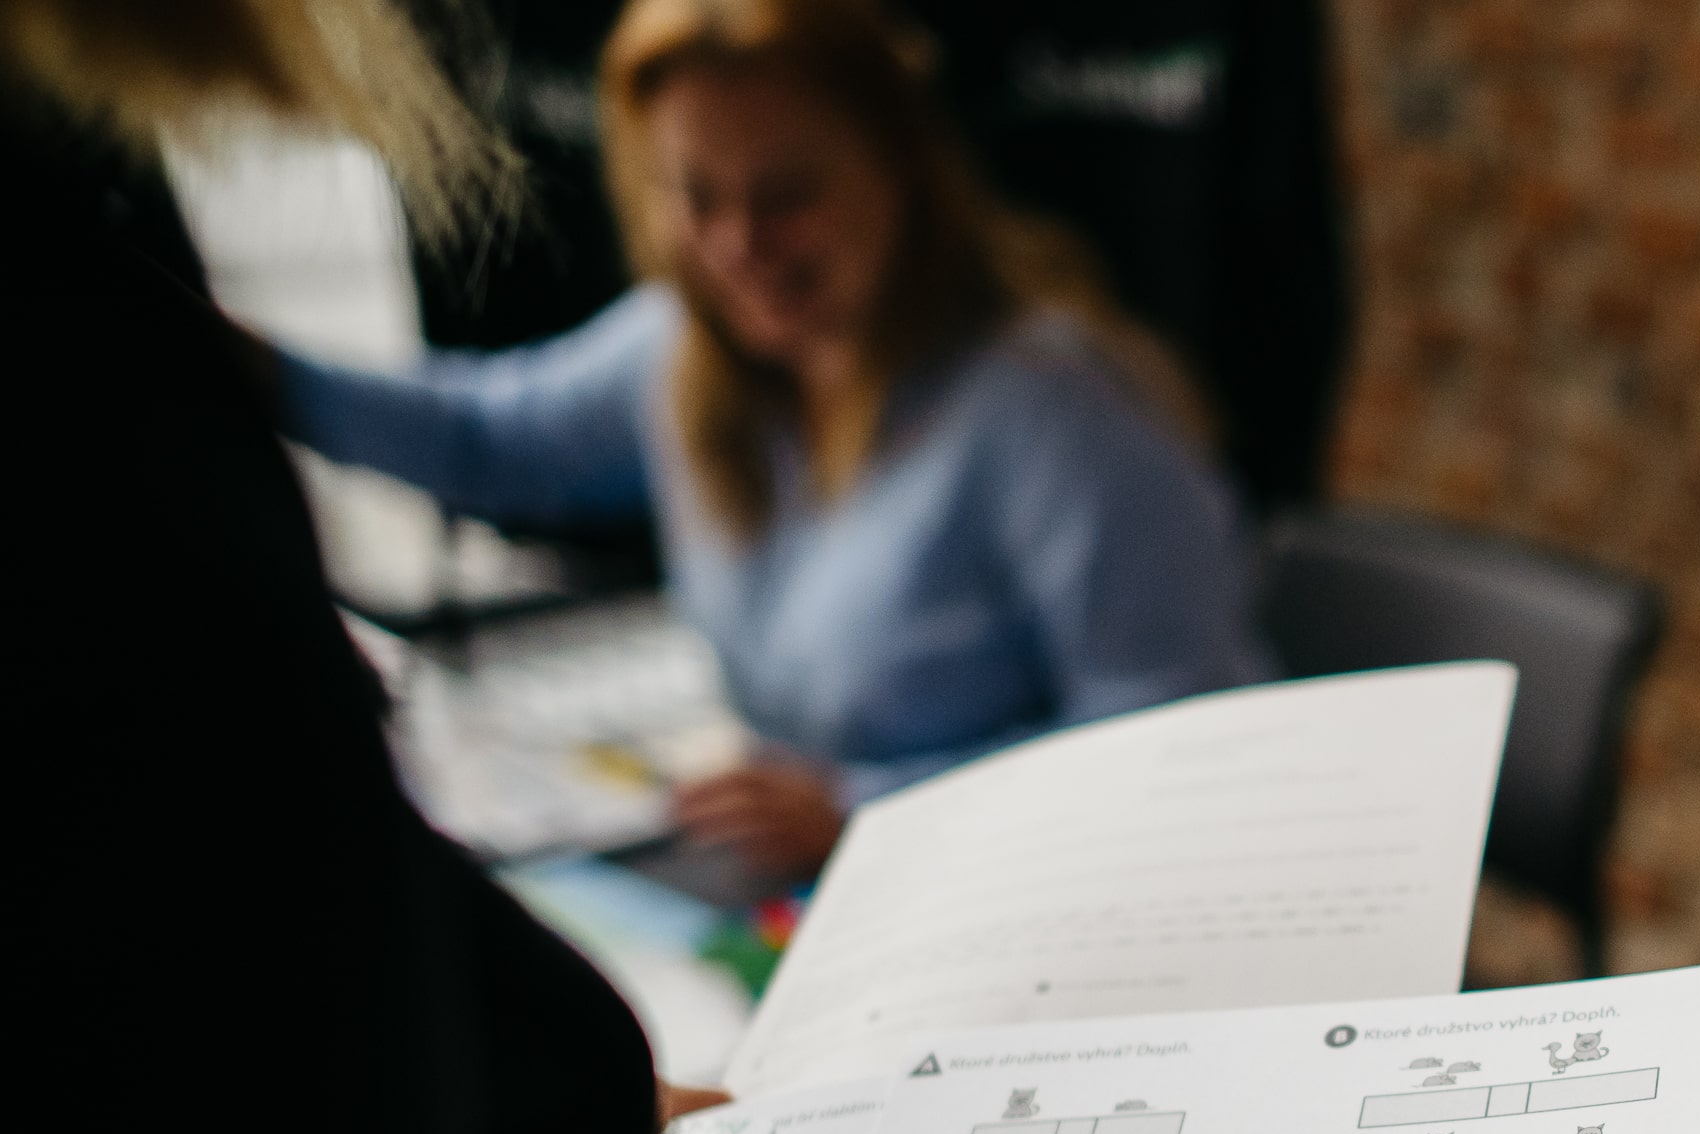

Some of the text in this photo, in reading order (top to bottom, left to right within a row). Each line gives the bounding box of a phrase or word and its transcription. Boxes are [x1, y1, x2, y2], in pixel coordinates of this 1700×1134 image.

[1363, 1027, 1410, 1041] Ktoré
[1416, 1018, 1494, 1037] družstvo
[1498, 1011, 1558, 1030] vyhrá?
[1561, 1005, 1622, 1024] Doplň.
